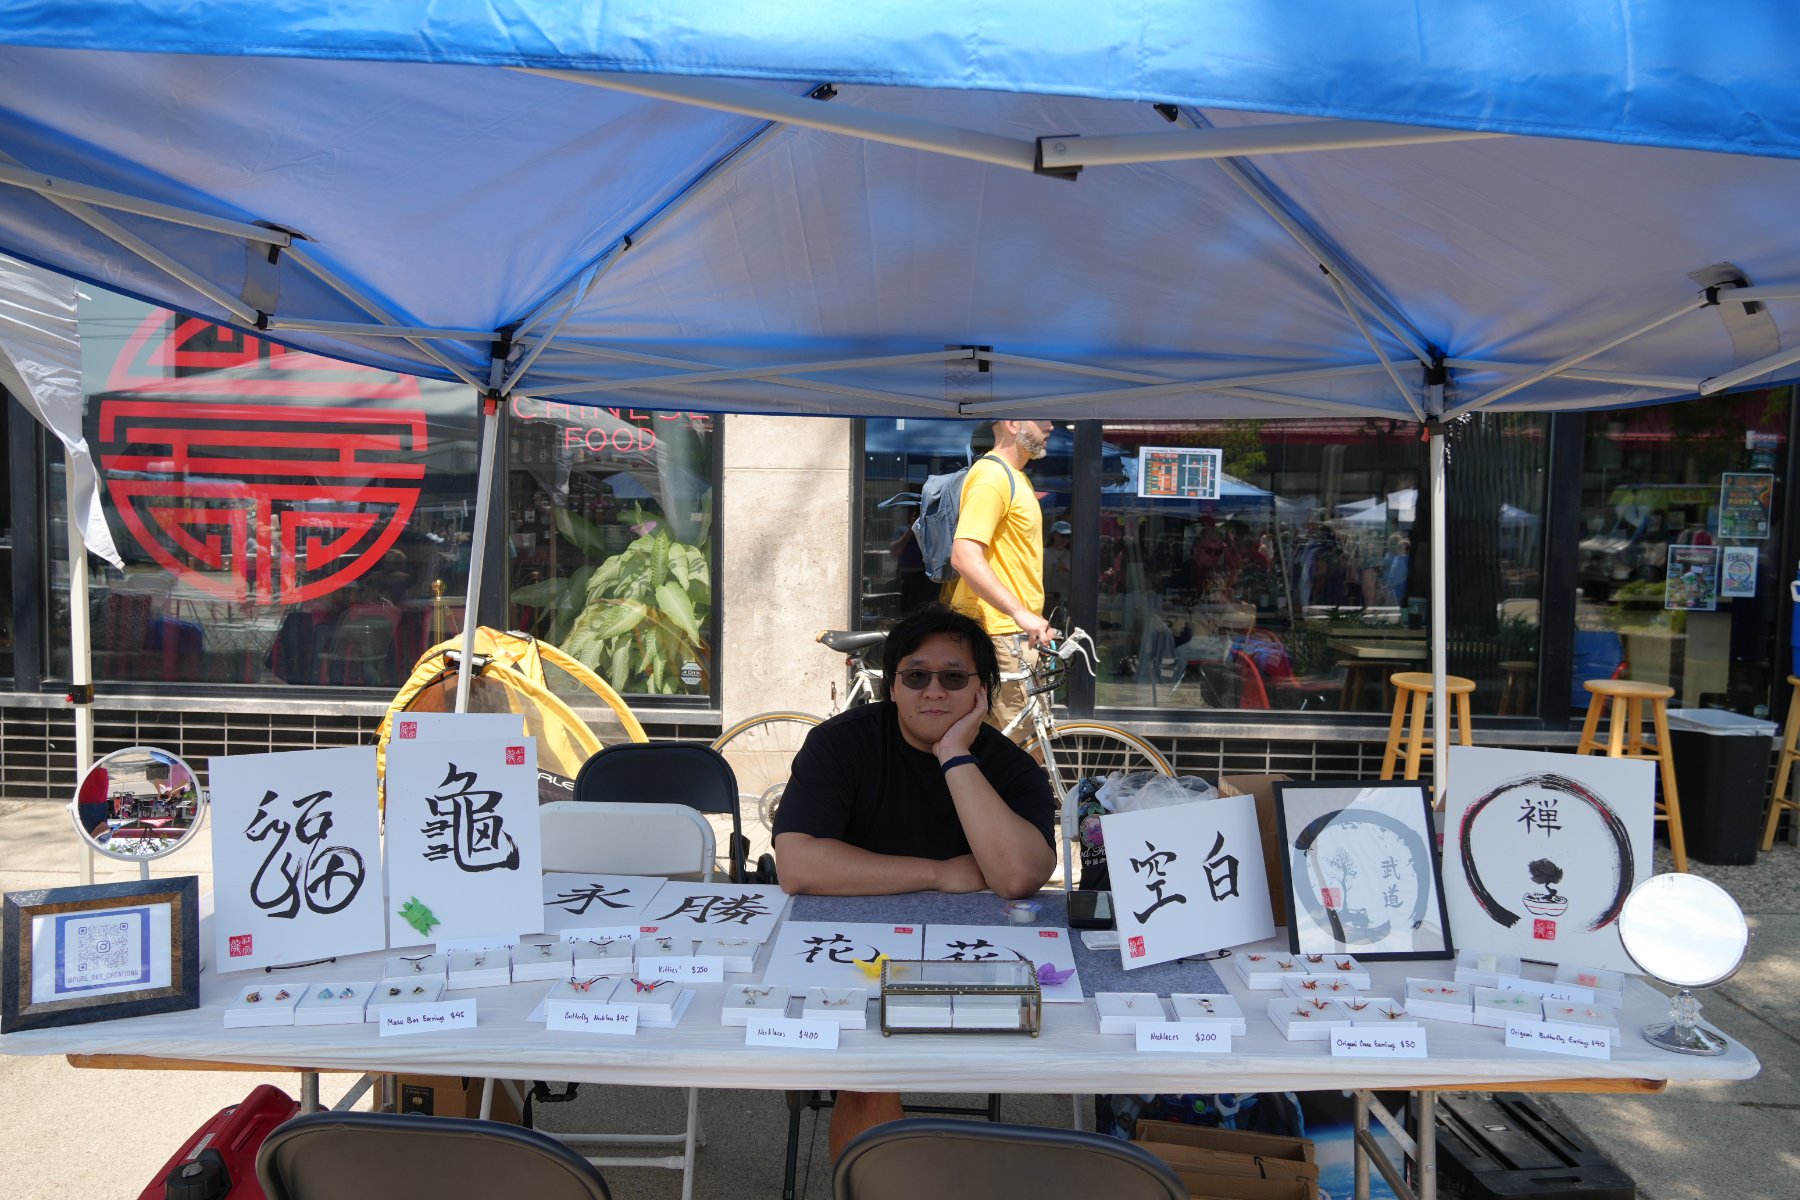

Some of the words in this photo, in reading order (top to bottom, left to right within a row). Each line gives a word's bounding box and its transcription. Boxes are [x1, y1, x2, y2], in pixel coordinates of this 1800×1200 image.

[564, 428, 656, 451] FOOD
[421, 762, 520, 872] 龜
[543, 883, 636, 915] 永
[654, 893, 773, 925] 勝
[794, 933, 881, 964] 花
[691, 966, 708, 974] $250
[450, 1011, 465, 1020] $45
[798, 1030, 819, 1040] $400
[1195, 1032, 1217, 1042] $200
[1510, 1028, 1533, 1038] Origami
[1400, 1040, 1416, 1048] $50
